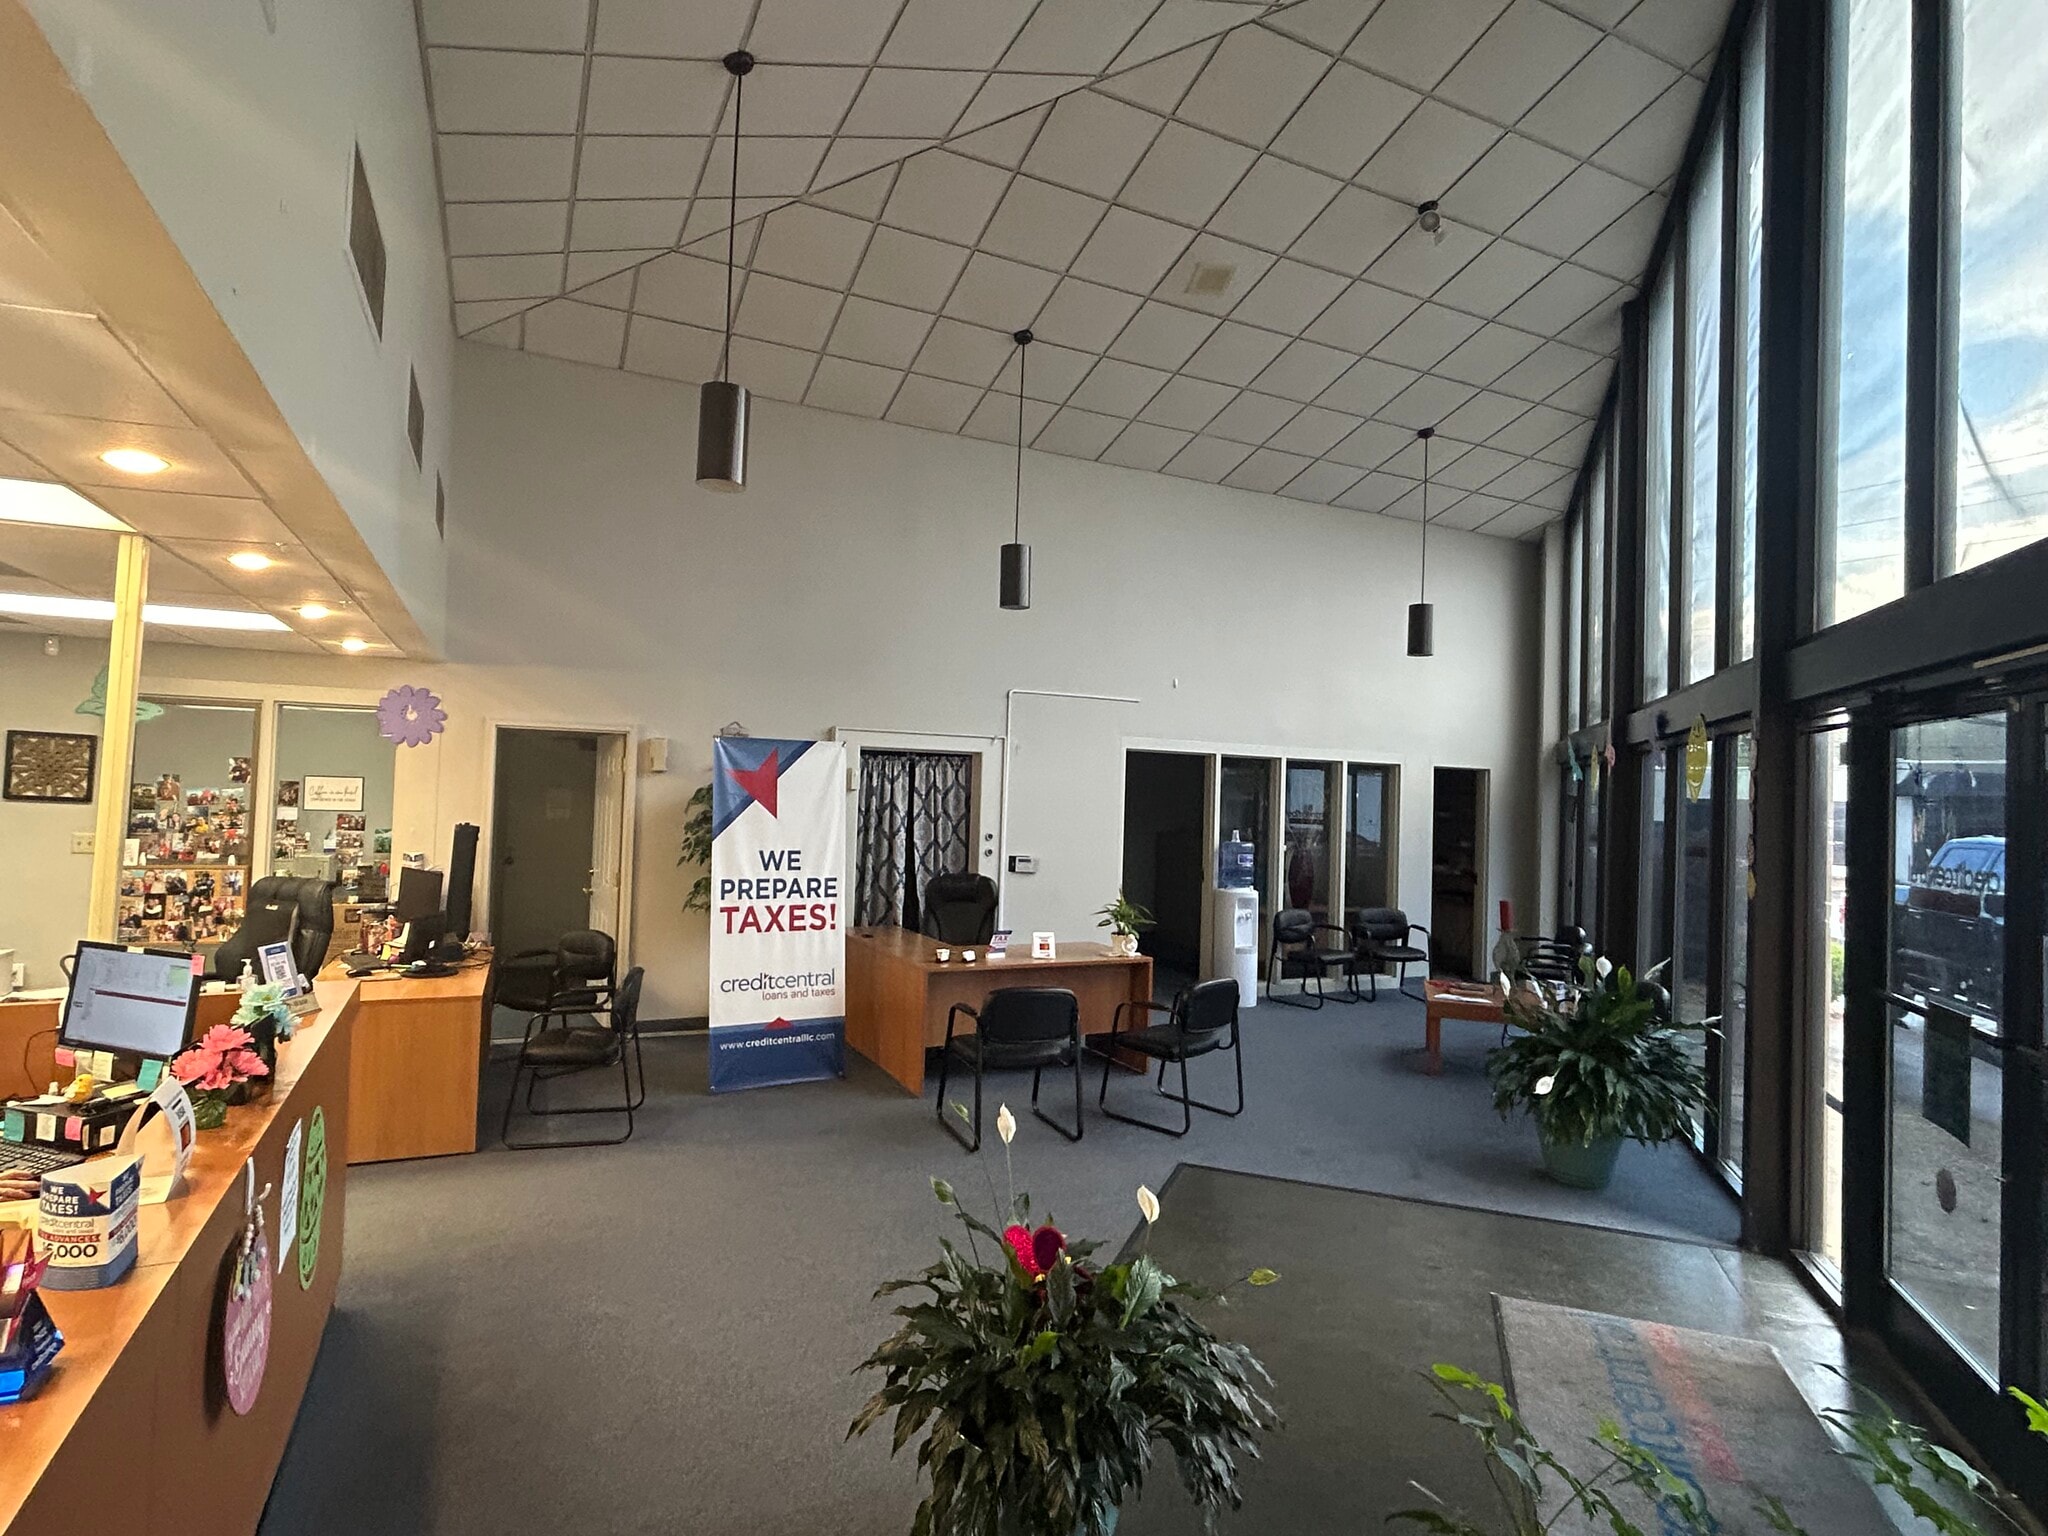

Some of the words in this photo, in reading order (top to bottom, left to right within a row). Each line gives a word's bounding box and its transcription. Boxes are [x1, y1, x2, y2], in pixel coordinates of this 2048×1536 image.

[759, 850, 801, 871] WE
[720, 877, 837, 900] PREPARE
[719, 903, 837, 934] TAXES!
[720, 968, 835, 993] creditcentral
[762, 990, 788, 1001] loans
[790, 989, 808, 998] and
[811, 987, 836, 997] taxes
[719, 1032, 836, 1050] www.creditcentralllc.com
[50, 1185, 64, 1195] WE
